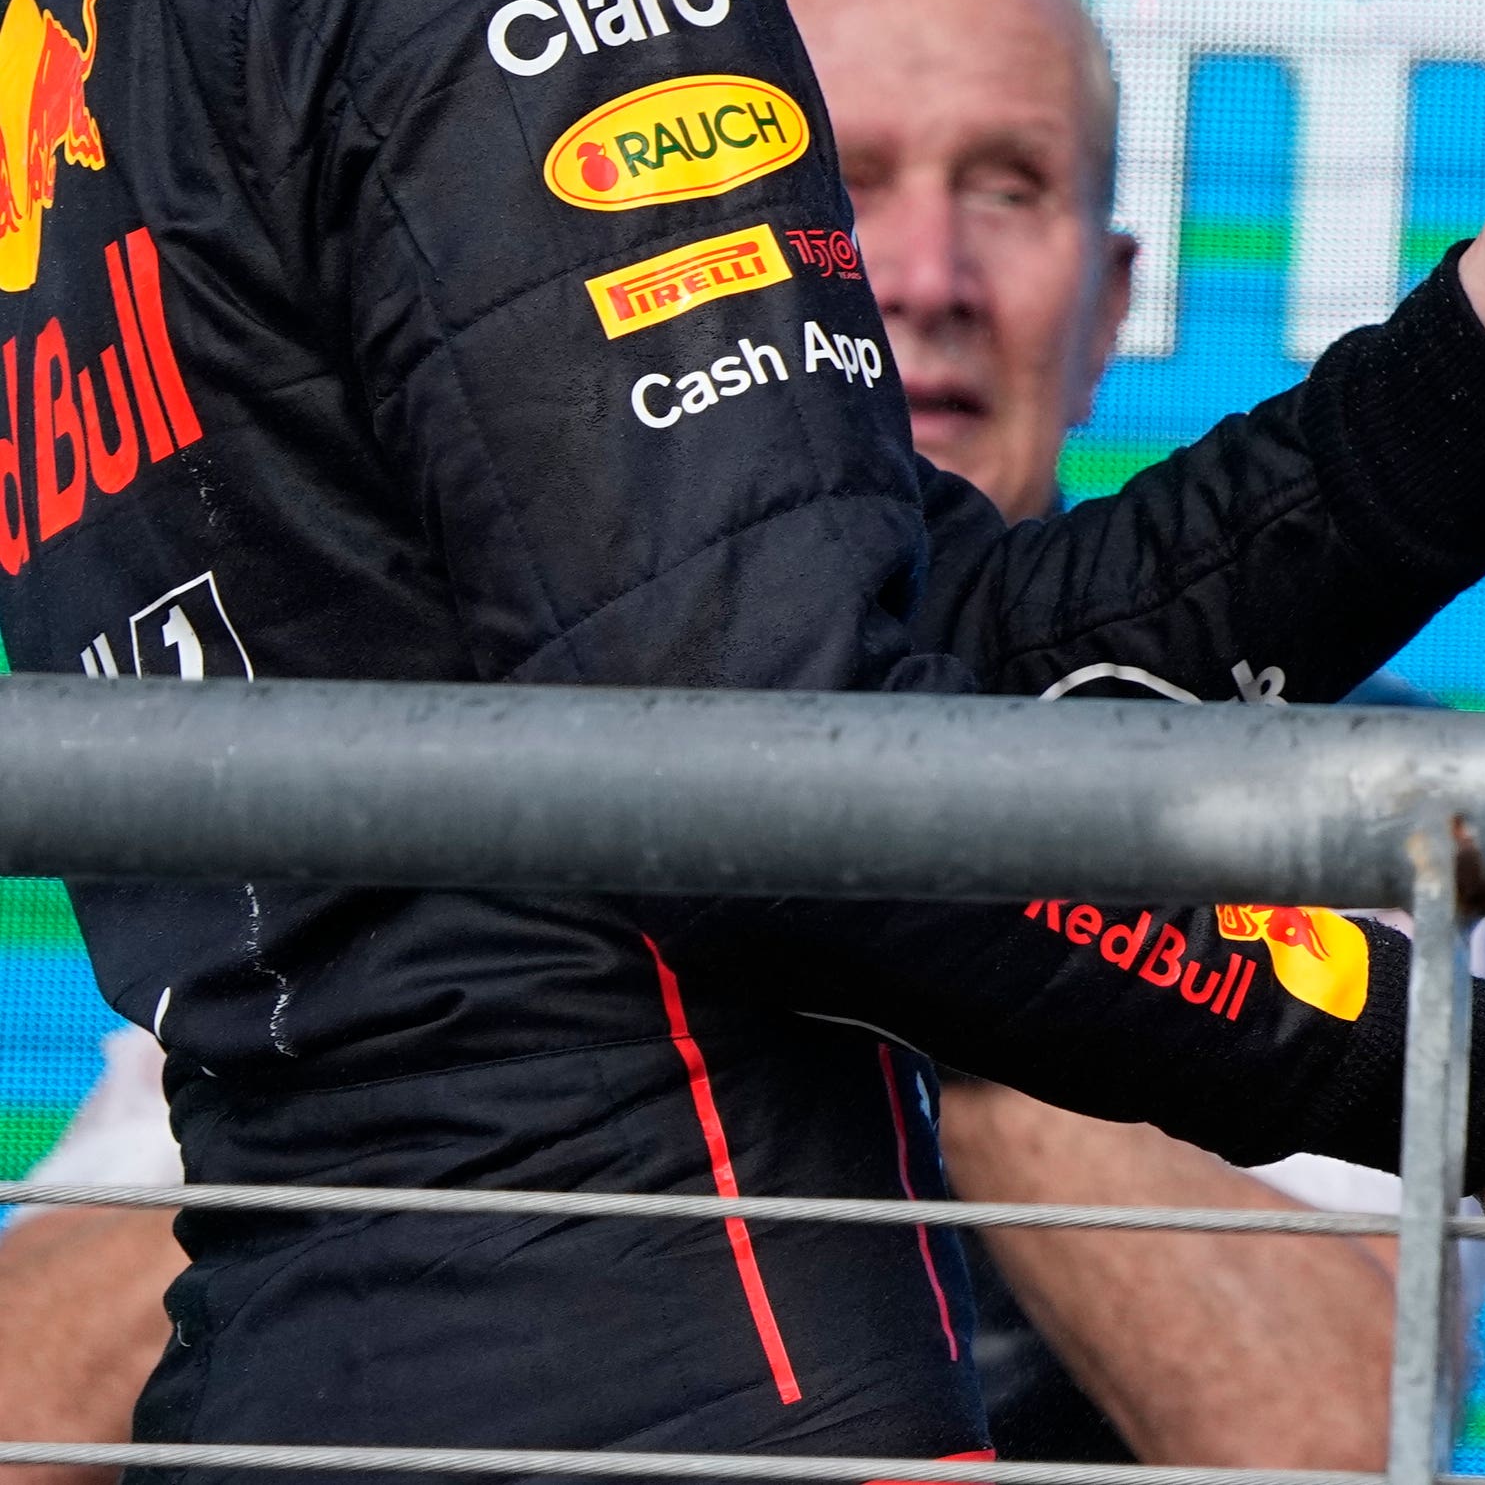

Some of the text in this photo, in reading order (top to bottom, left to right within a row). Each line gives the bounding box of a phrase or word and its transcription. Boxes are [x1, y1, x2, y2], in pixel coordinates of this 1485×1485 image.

[614, 101, 788, 181] RAUCH
[606, 229, 857, 321] PIRELLI 150
[631, 321, 882, 429] Cash App
